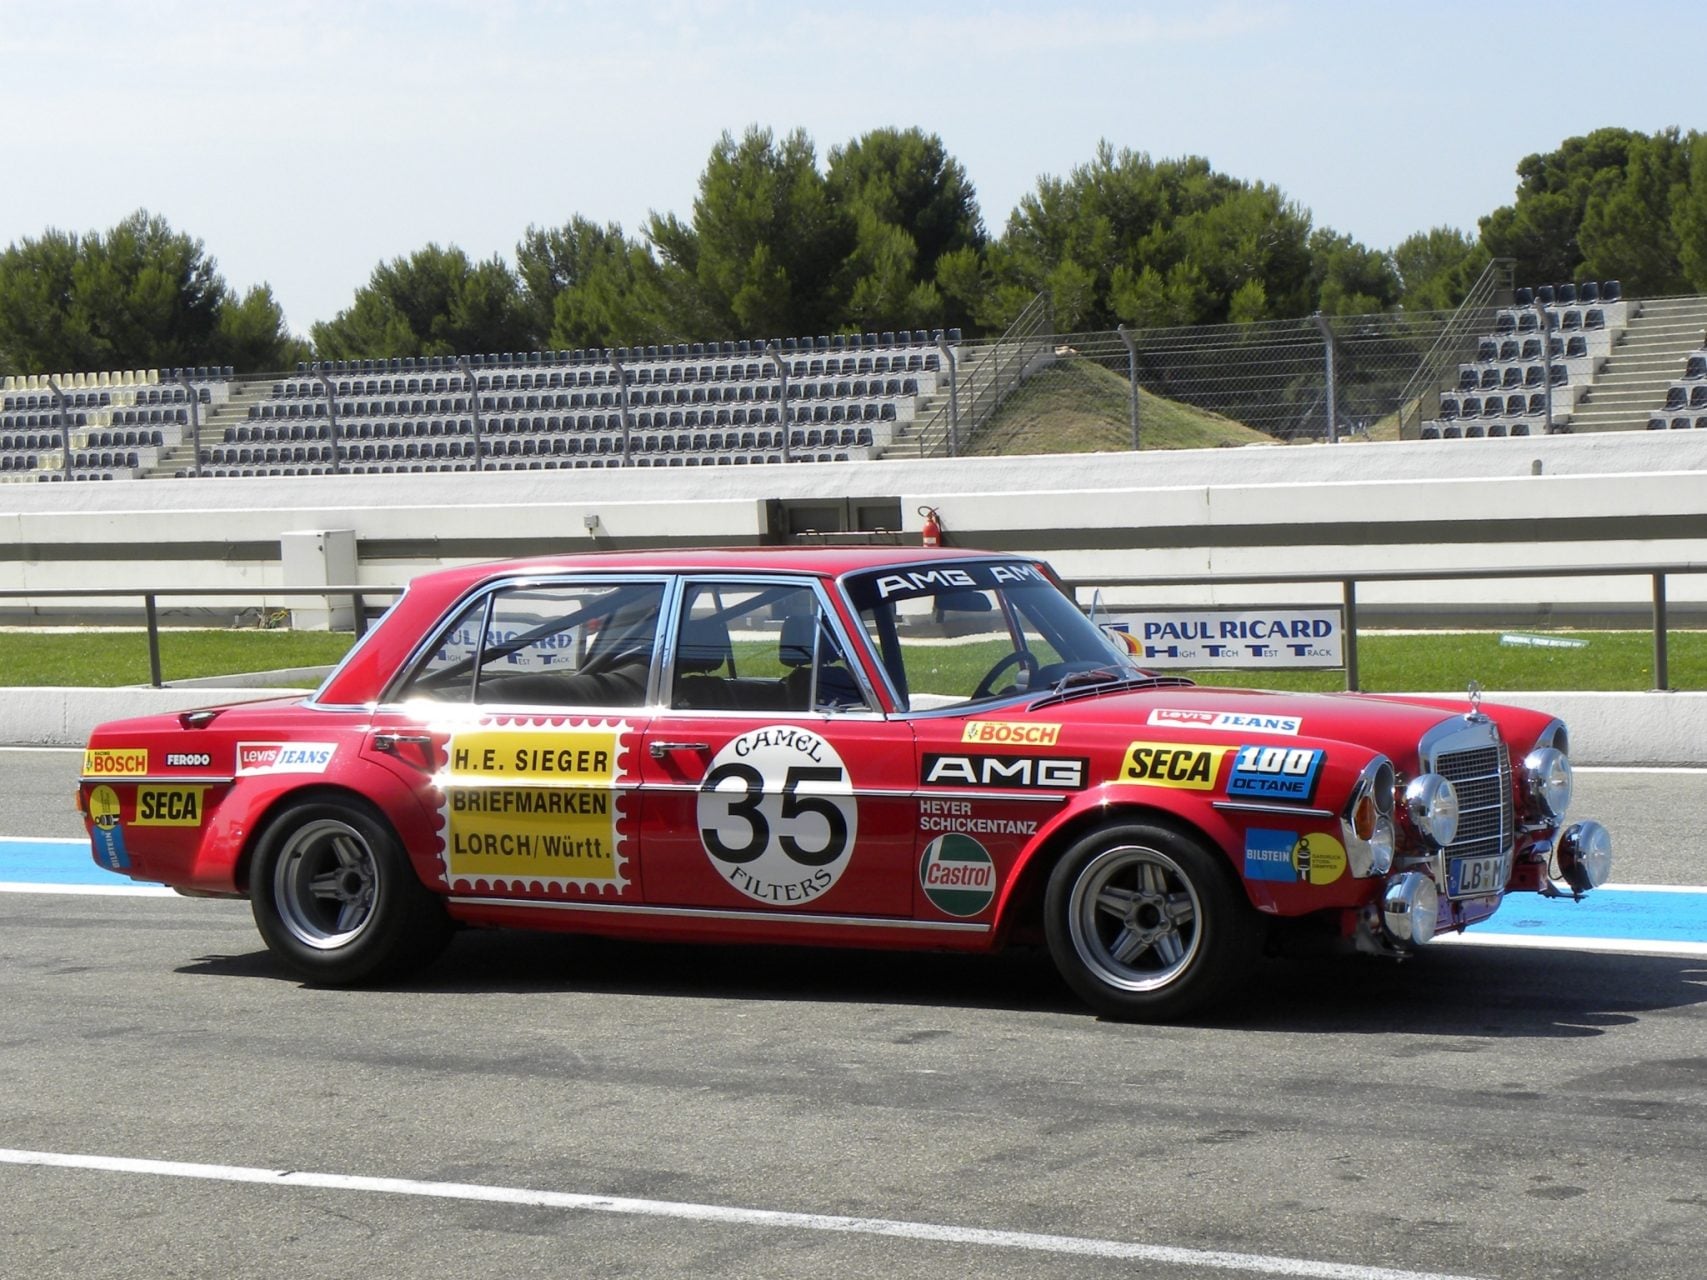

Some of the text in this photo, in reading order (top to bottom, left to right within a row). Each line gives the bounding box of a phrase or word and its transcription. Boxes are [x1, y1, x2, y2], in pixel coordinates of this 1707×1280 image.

[876, 569, 976, 599] AMG
[1144, 619, 1332, 640] PAUL RICARD
[537, 654, 569, 665] TRACK
[1145, 643, 1332, 658] HIGH TECH TEST TRACK
[979, 725, 1056, 743] BOSCH
[1222, 715, 1296, 731] JEANS
[280, 750, 330, 764] JEANS
[735, 729, 822, 763] CAMEL
[94, 755, 146, 773] BOSCH
[167, 754, 210, 766] FERODO
[455, 748, 608, 772] H.E. SIEGER
[926, 757, 1082, 787] AMG
[1128, 748, 1212, 782] SECA
[1236, 746, 1315, 775] 100
[1232, 778, 1305, 793] OCTANE
[141, 791, 198, 820] SECA
[453, 790, 607, 815] BRIEFMARKEN
[700, 762, 848, 866] 35
[920, 801, 972, 816] HEYER
[920, 818, 1038, 835] SCHICKENTANZ
[454, 833, 611, 859] LORCH/Württ.
[1246, 849, 1290, 862] BILSTEIN
[729, 866, 832, 900] FILTERS
[927, 863, 991, 887] Castrol
[1460, 862, 1482, 890] LB
